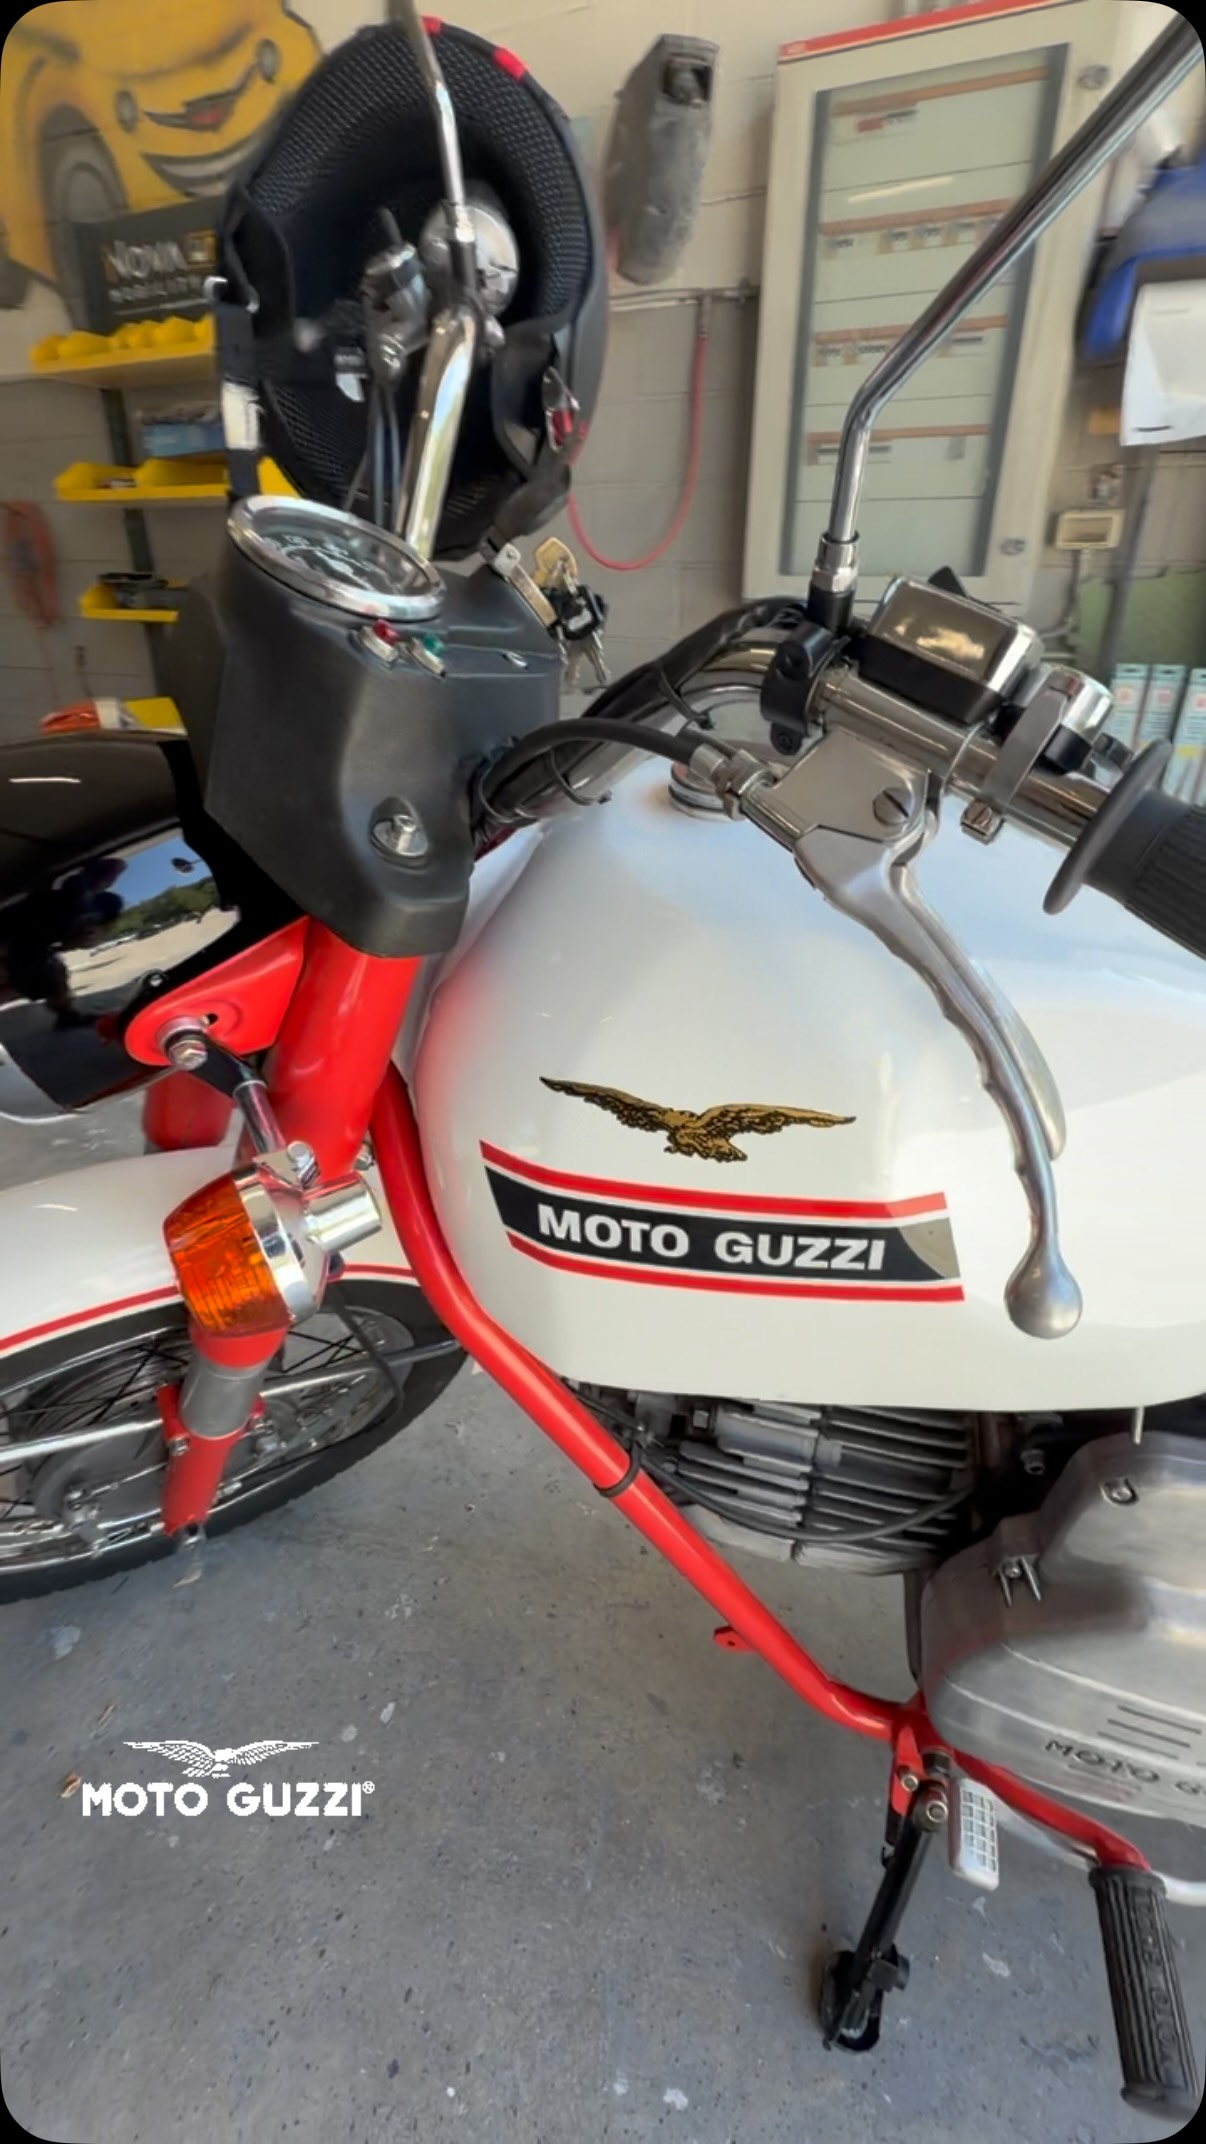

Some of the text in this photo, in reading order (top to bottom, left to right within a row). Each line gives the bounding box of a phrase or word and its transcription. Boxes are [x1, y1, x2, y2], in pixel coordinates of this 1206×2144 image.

[538, 1203, 885, 1271] MOTO GUZZI
[1045, 1740, 1160, 1783] MOTO
